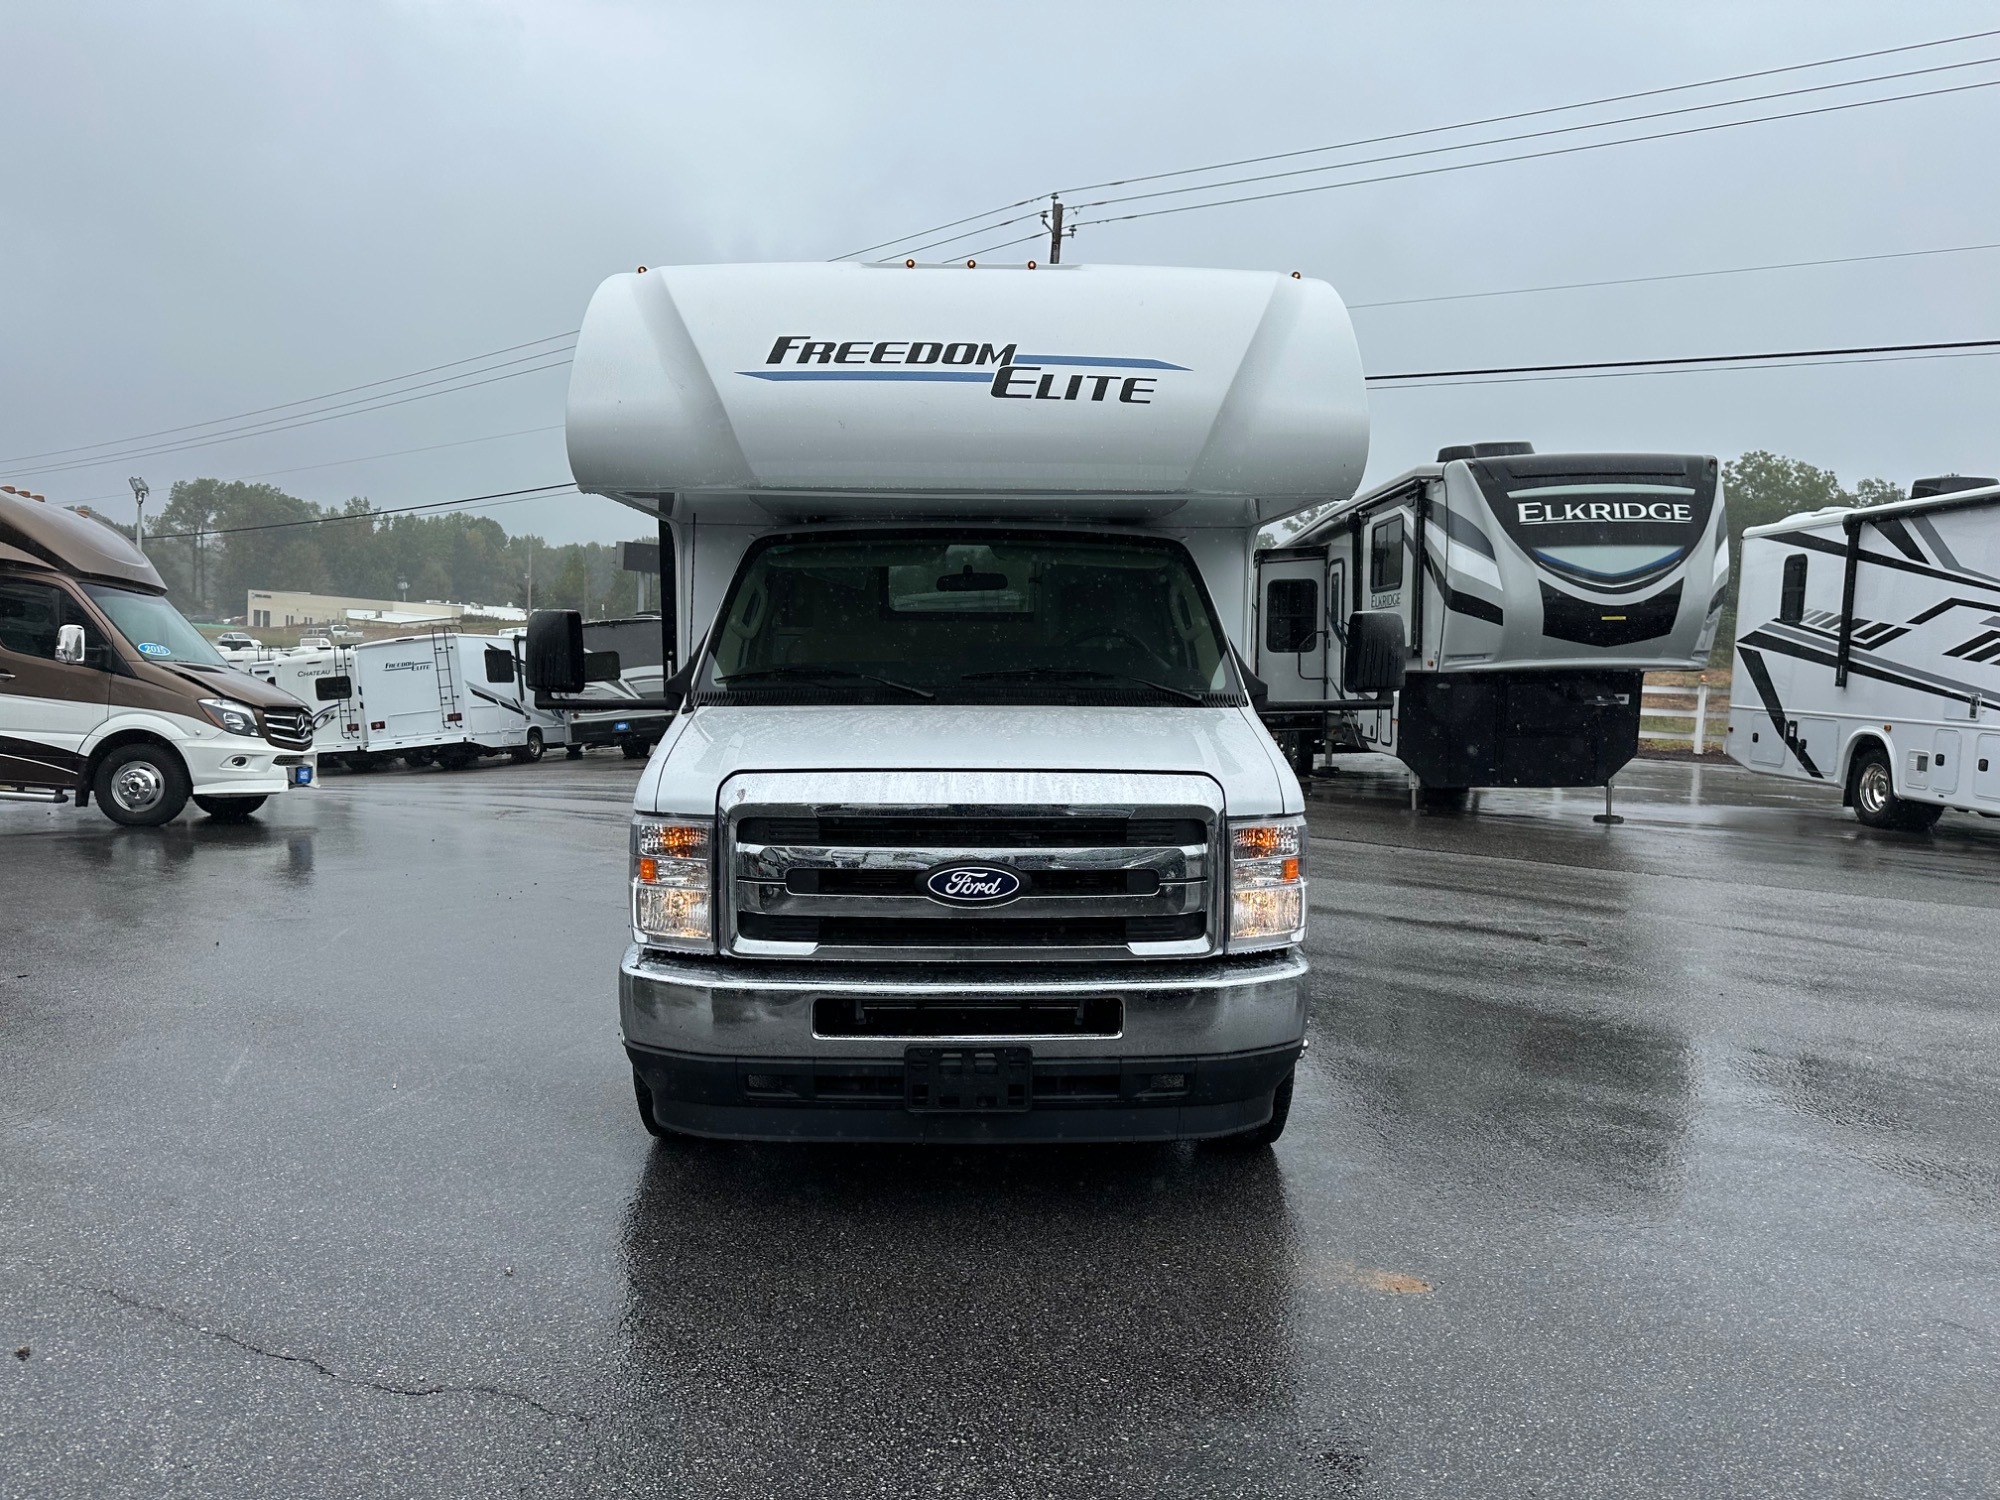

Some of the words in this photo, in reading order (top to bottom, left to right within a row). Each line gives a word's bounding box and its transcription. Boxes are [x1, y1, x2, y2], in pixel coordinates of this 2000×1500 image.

[766, 336, 1017, 365] FREEDOM
[990, 366, 1158, 404] ELITE
[1517, 502, 1693, 525] ELKRIDGE
[297, 669, 331, 677] CHATEAU
[945, 871, 1002, 895] Ford
